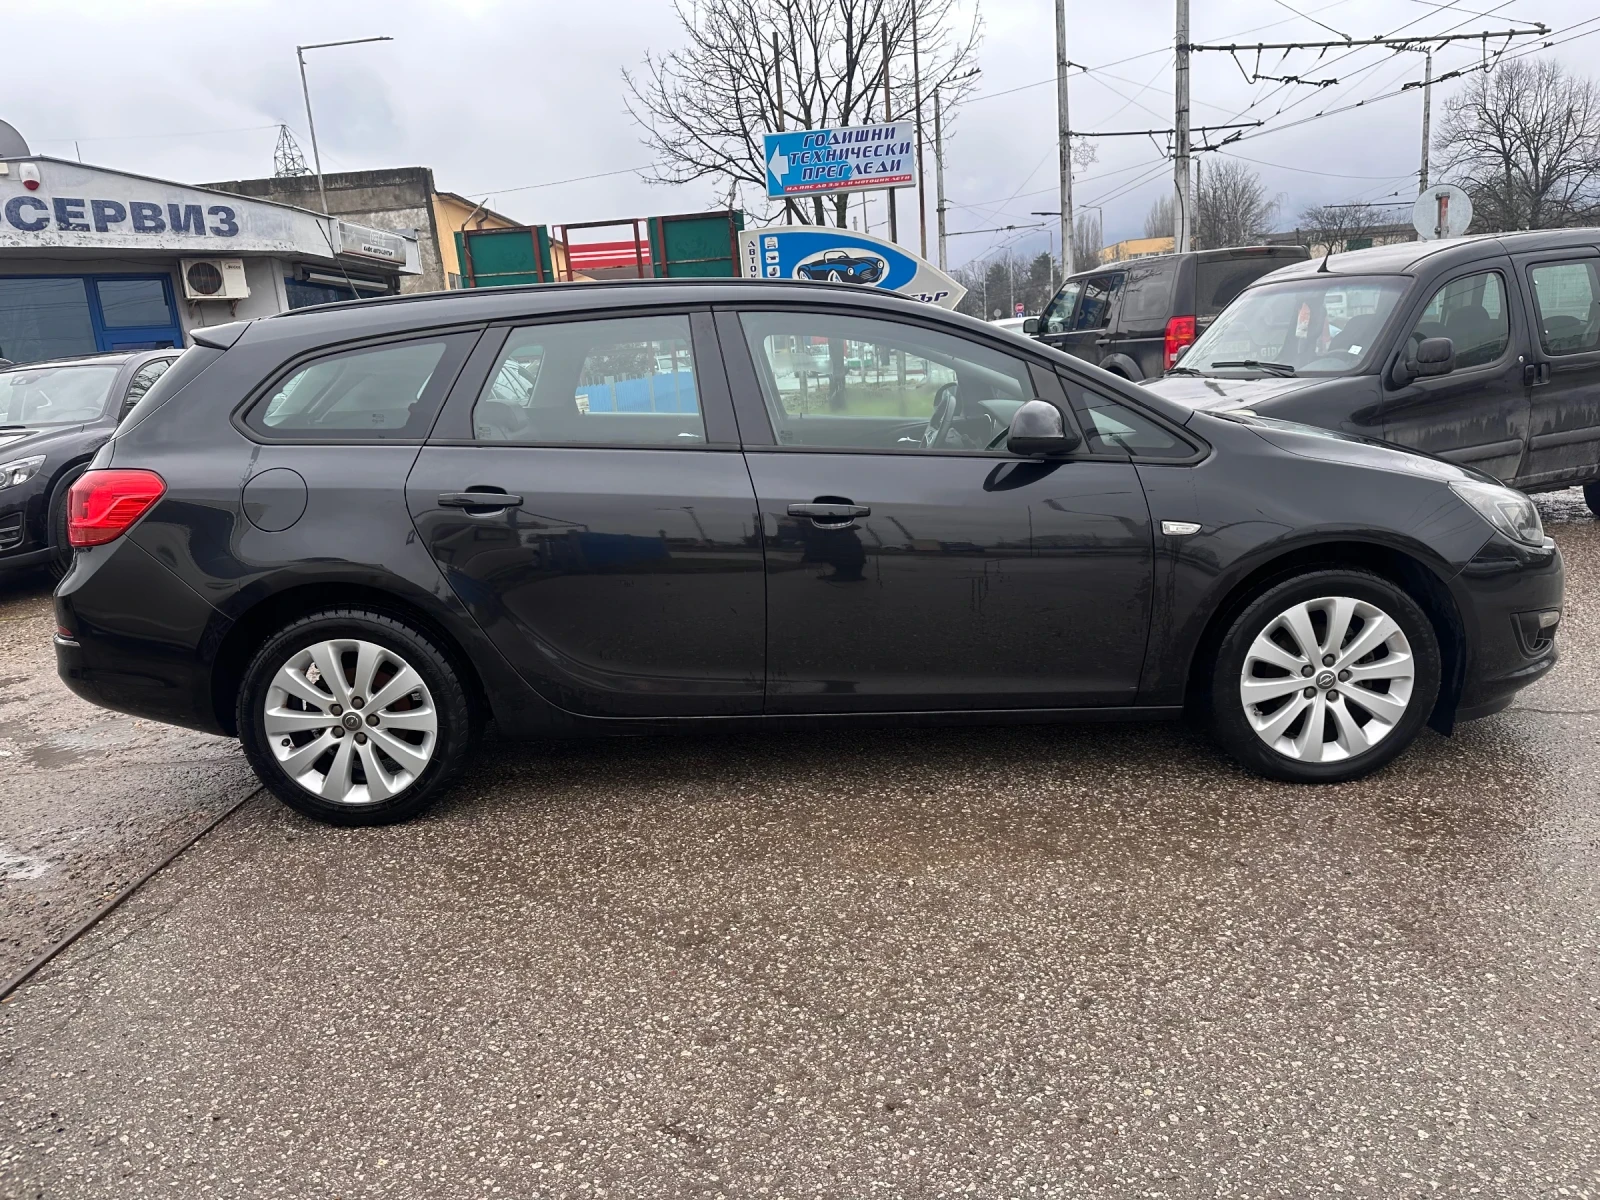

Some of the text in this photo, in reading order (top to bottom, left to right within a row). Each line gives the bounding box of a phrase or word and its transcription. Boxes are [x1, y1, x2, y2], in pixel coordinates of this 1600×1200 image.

[803, 127, 896, 148] ГОДИШНИ
[790, 142, 911, 166] ТЕХНИЧЕСКИ
[802, 159, 901, 180] ПРЕГЛЕДИ
[0, 195, 239, 237] СЕРВИЗ
